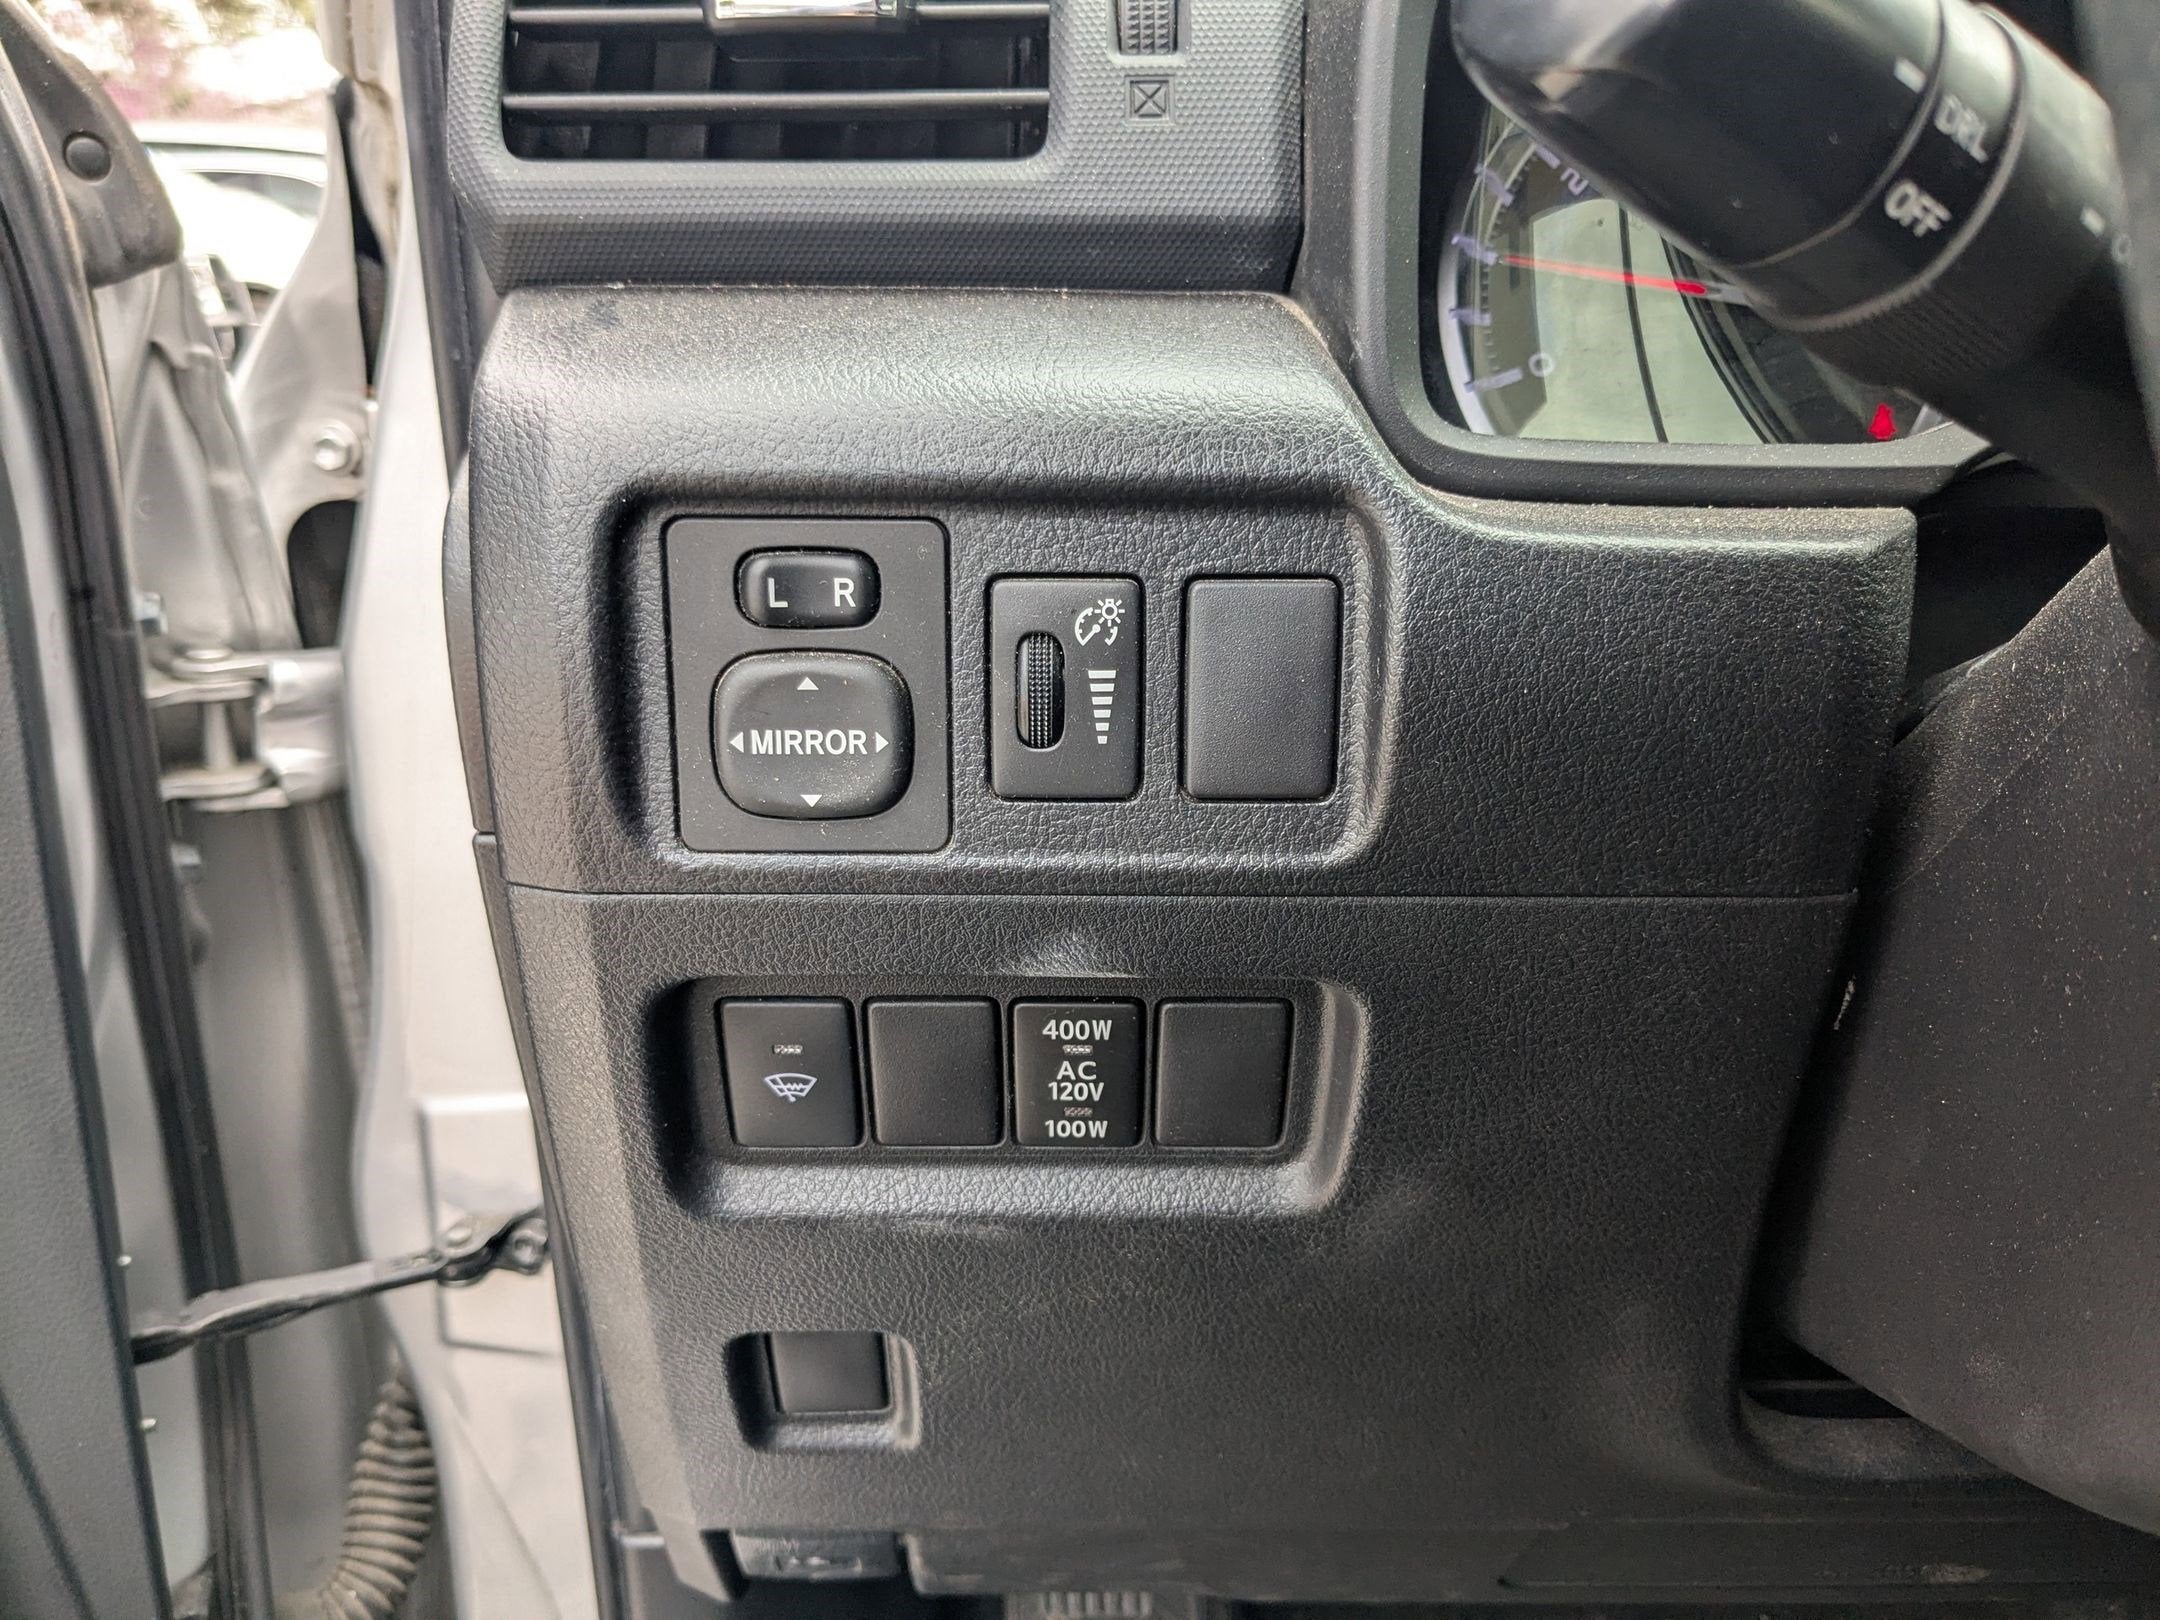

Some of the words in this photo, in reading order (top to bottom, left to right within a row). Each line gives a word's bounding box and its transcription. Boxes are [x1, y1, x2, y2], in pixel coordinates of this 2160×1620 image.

[1560, 167, 1590, 196] 2
[1884, 179, 1951, 238] OFF
[767, 577, 789, 608] L
[833, 577, 857, 608] R
[751, 729, 868, 756] MIRROR
[1042, 1019, 1113, 1041] 400W
[1056, 1060, 1097, 1081] AC
[1048, 1081, 1105, 1102] 120V
[1045, 1119, 1108, 1139] 100W
